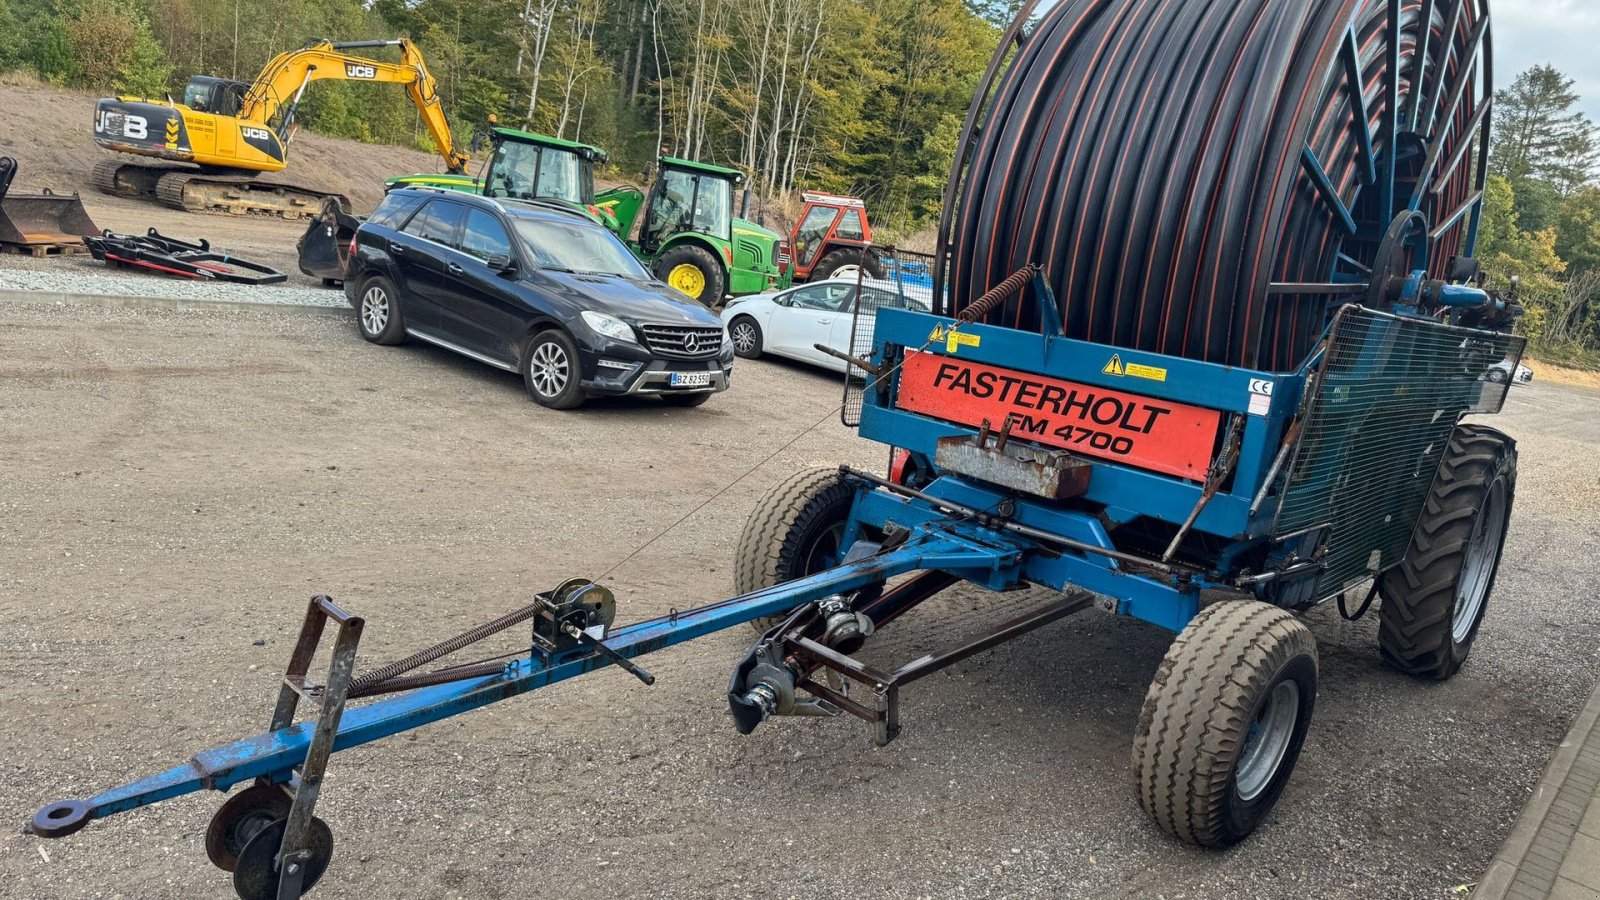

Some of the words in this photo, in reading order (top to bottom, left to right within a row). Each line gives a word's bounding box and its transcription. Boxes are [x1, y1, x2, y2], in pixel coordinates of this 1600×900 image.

[347, 65, 375, 78] JCB
[242, 127, 269, 140] JCB
[933, 363, 1171, 434] FASTERHOLT
[1006, 411, 1049, 435] FM
[1053, 424, 1133, 455] 4700
